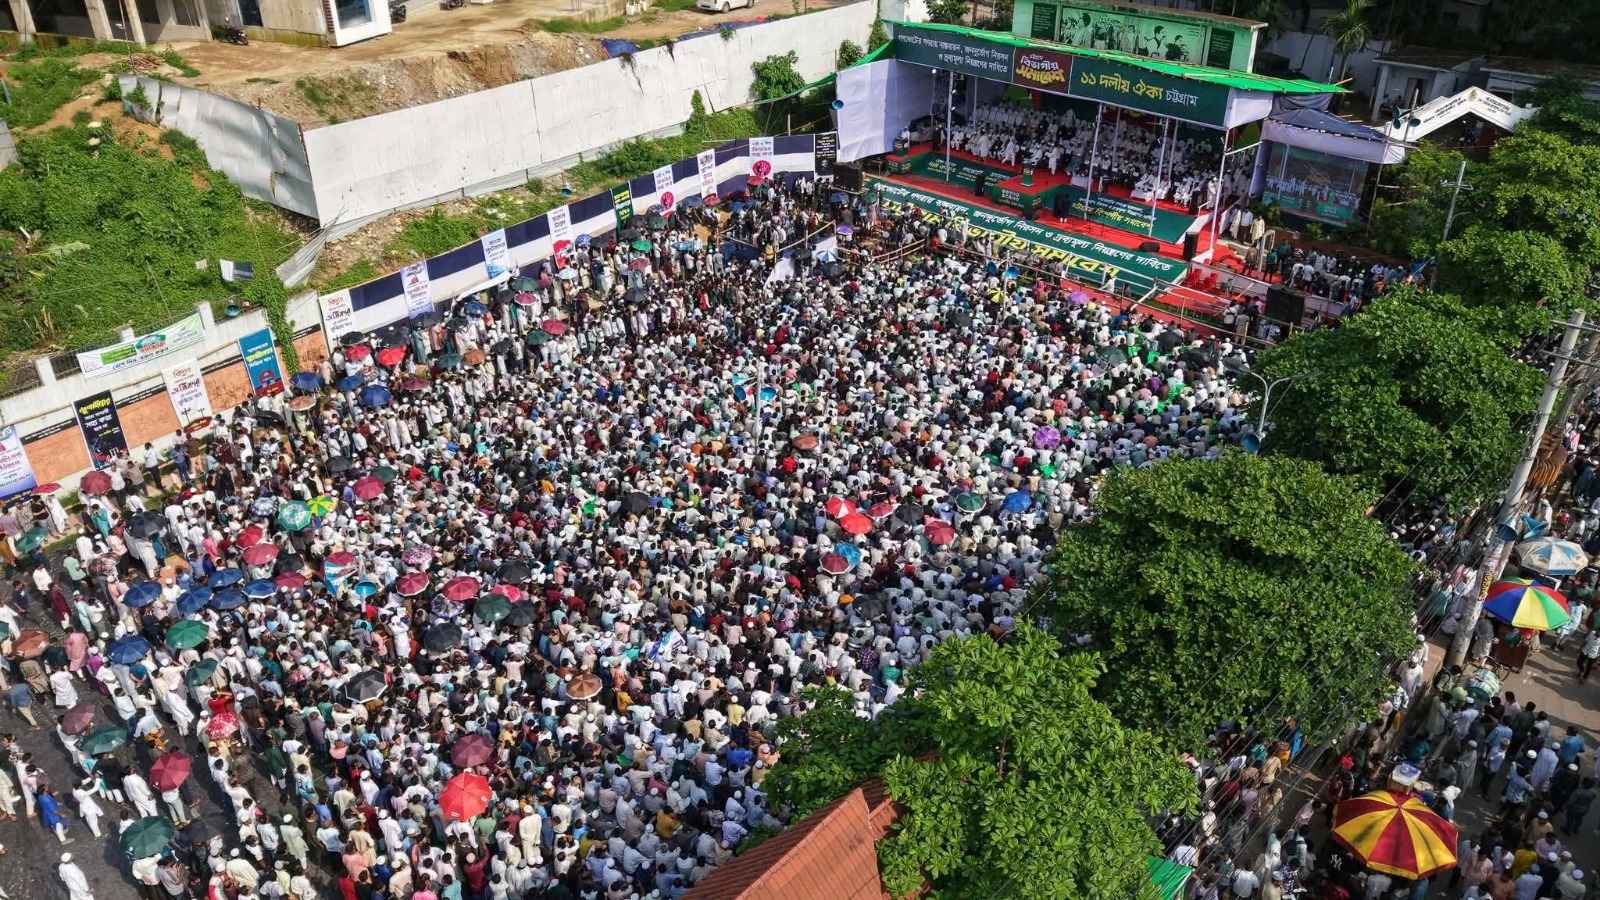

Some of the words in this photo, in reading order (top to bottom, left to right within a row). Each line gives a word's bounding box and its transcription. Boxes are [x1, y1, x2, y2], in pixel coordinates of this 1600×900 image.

[1020, 55, 1059, 71] বিভাগীয়
[1080, 71, 1097, 85] ১১
[1099, 73, 1130, 93] দলীয়
[1132, 79, 1164, 100] ঐক্য
[1165, 89, 1199, 106] চট্টগ্রাম
[1135, 255, 1174, 271] দাবিতে
